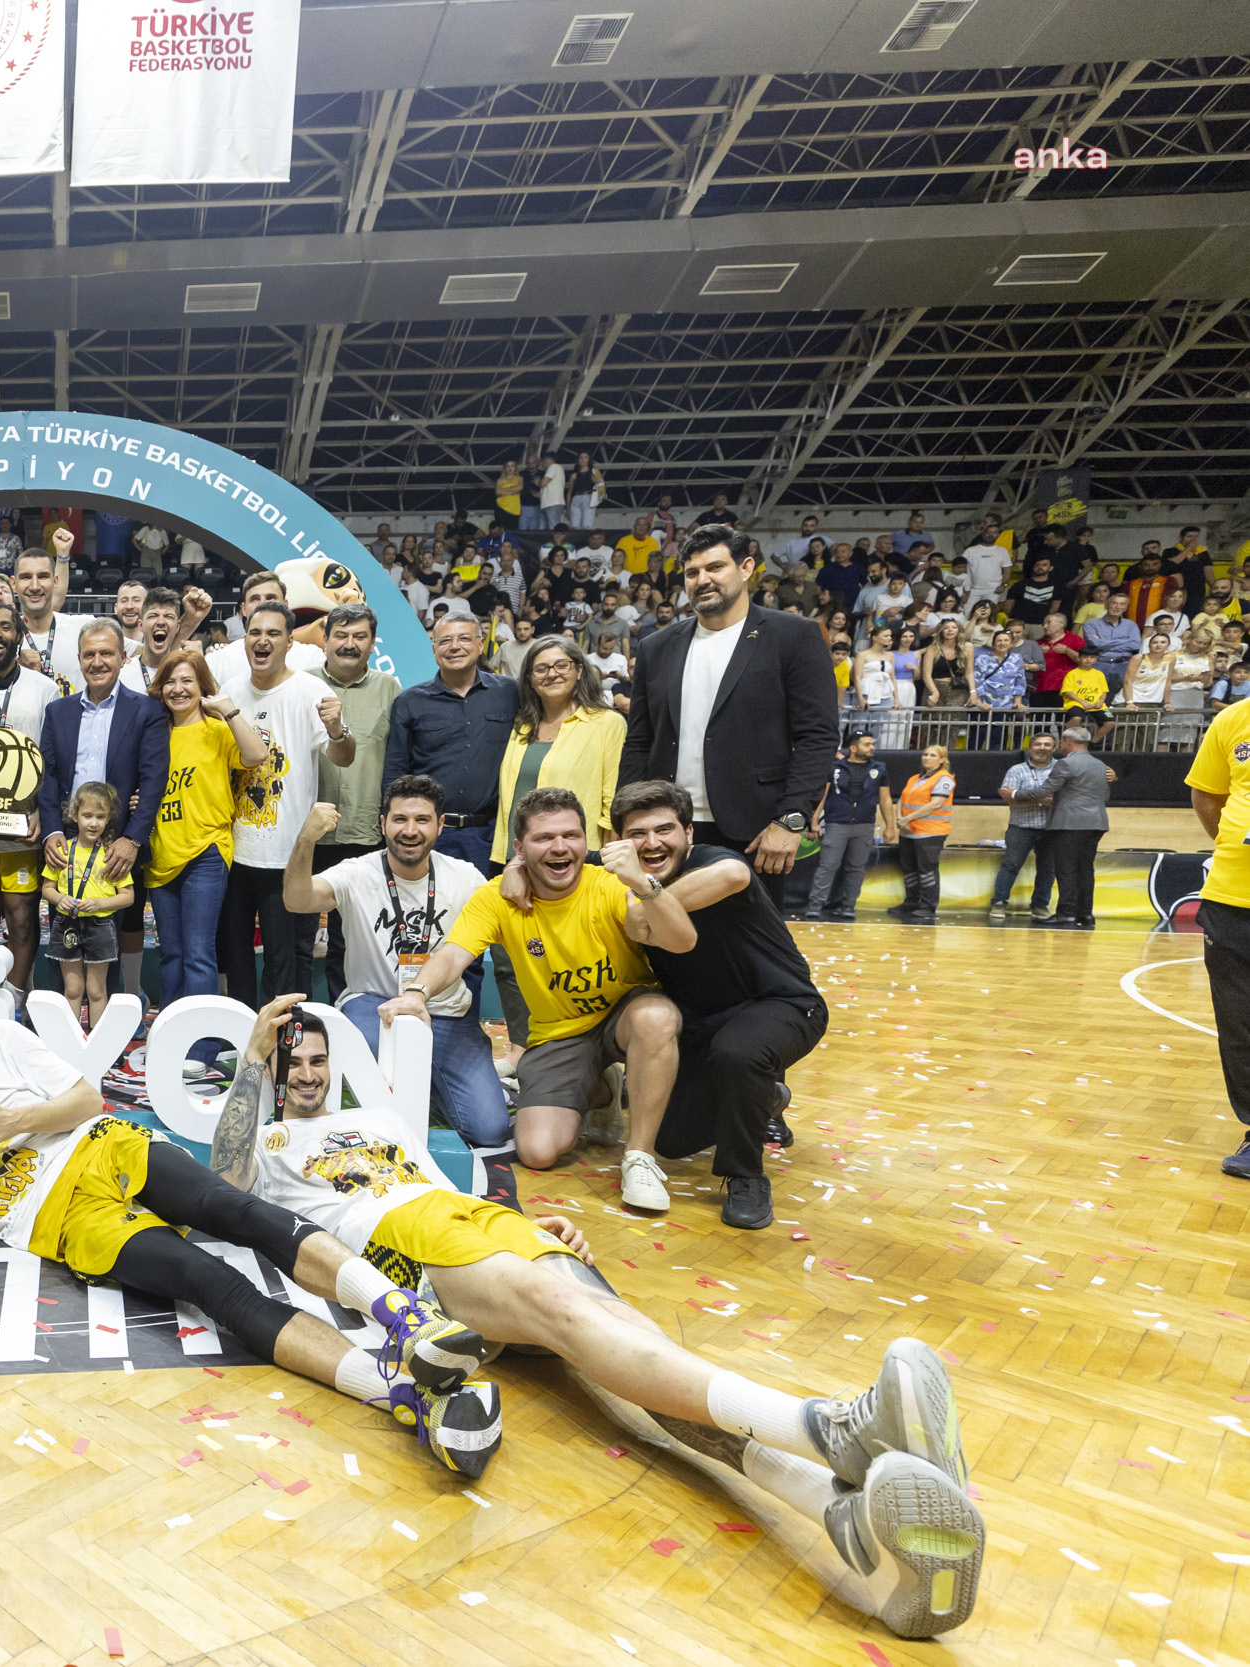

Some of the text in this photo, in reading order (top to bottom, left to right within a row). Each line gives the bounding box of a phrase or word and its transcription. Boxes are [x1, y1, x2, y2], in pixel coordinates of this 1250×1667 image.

[131, 6, 254, 38] TÜRKİYE
[130, 37, 253, 57] BASKETBOL
[129, 55, 252, 73] FEDERASYONU
[28, 423, 142, 457] TÜRKİYE
[145, 444, 290, 537] BASKETBOL
[162, 766, 197, 798] SK
[161, 800, 183, 823] 33
[570, 994, 612, 1015] 33
